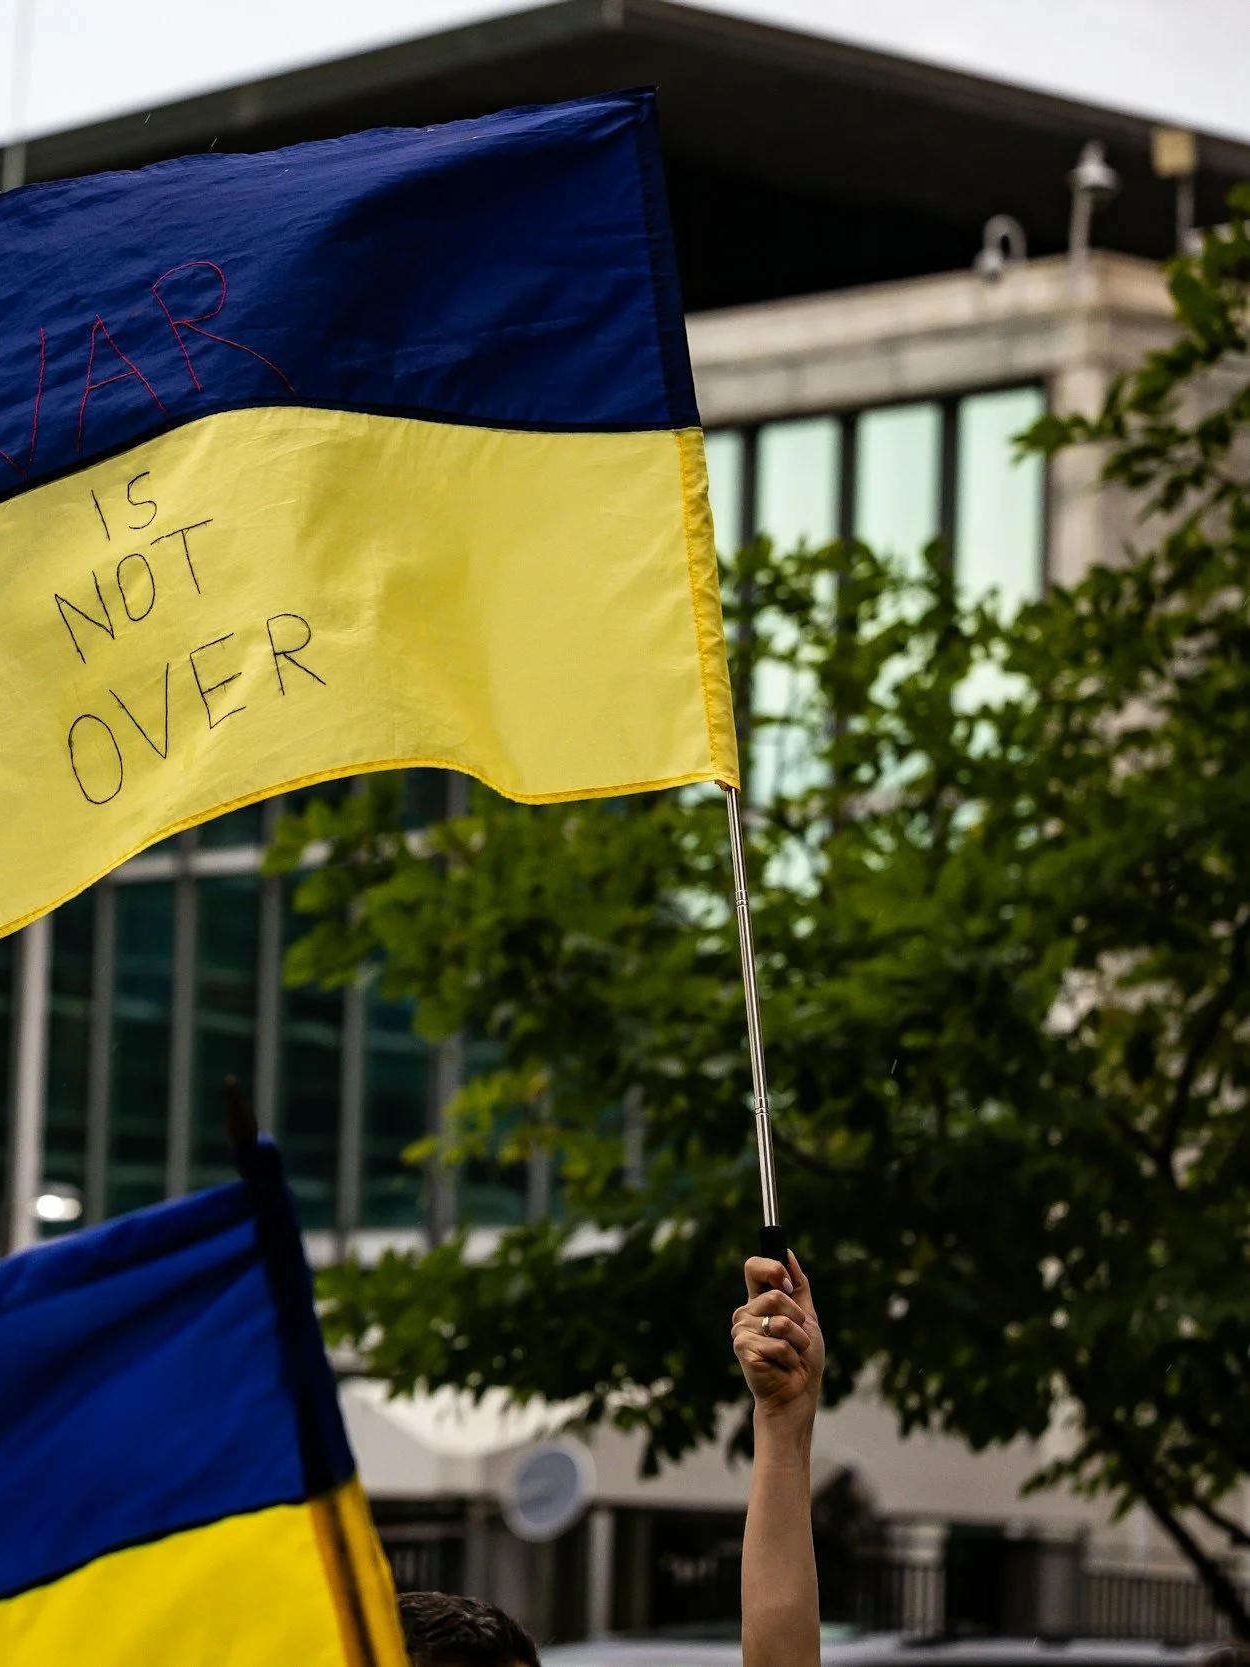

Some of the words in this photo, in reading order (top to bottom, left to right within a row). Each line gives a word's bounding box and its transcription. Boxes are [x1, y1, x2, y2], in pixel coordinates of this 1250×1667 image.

[90, 471, 158, 542] IS
[54, 518, 214, 665] NOT
[67, 612, 327, 805] OVER
